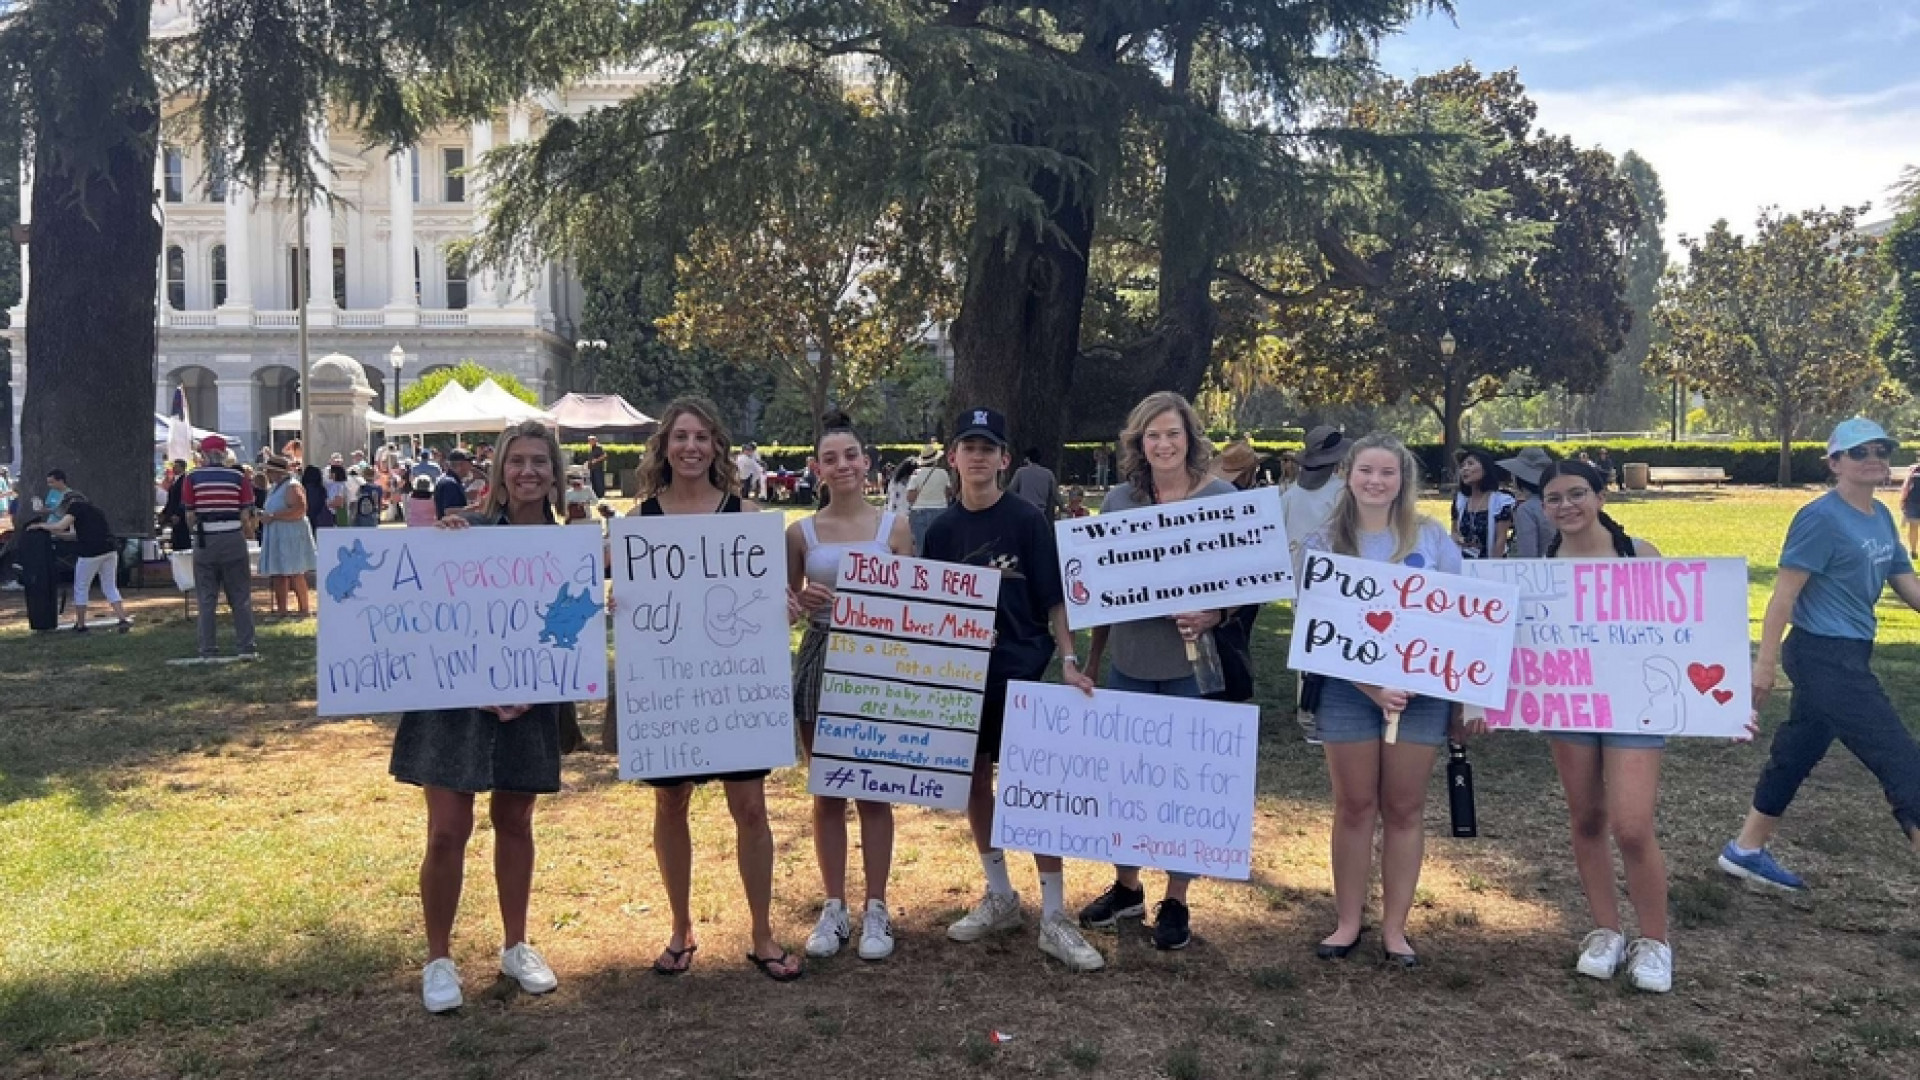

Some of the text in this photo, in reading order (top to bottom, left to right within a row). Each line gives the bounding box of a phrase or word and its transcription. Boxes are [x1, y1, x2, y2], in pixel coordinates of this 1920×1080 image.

[1157, 505, 1236, 529] having
[1242, 503, 1256, 516] a
[392, 543, 597, 597] A person's a
[623, 534, 767, 581] Pro-Life
[1097, 545, 1167, 567] clump
[1169, 538, 1192, 554] of
[844, 553, 984, 599] JESUS IS REAL
[1100, 570, 1294, 608] Said no one ever.
[1303, 555, 1510, 624] Pro Love
[1492, 561, 1567, 594] TRUE
[1573, 561, 1707, 623] FEMINIST
[357, 599, 529, 643] person, no
[632, 590, 684, 645] adj.
[832, 597, 991, 640] Unborn Lives Matter
[1531, 624, 1563, 645] FOR
[1568, 624, 1600, 643] THE
[1609, 625, 1664, 645] RIGHTS
[1673, 627, 1693, 645] OF
[328, 649, 416, 693] matter
[430, 643, 478, 690] how
[653, 655, 694, 680] The
[700, 655, 766, 678] radical
[864, 643, 875, 653] a
[1304, 618, 1493, 693] Pro Life
[896, 659, 983, 682] not a choice
[625, 683, 790, 714] belief that babies
[822, 676, 974, 709] Unborn baby rights
[626, 710, 789, 741] deserve a chance
[817, 717, 930, 746] Fearfully and
[860, 699, 977, 727] are human rights
[1082, 702, 1174, 748] noticed
[1187, 716, 1247, 758] that
[630, 742, 710, 774] at life.
[935, 755, 970, 769] made
[1006, 744, 1241, 795] everyone who is for
[1002, 779, 1241, 844] abortion has already
[1001, 815, 1051, 848] been
[1193, 838, 1249, 872] Reagan
